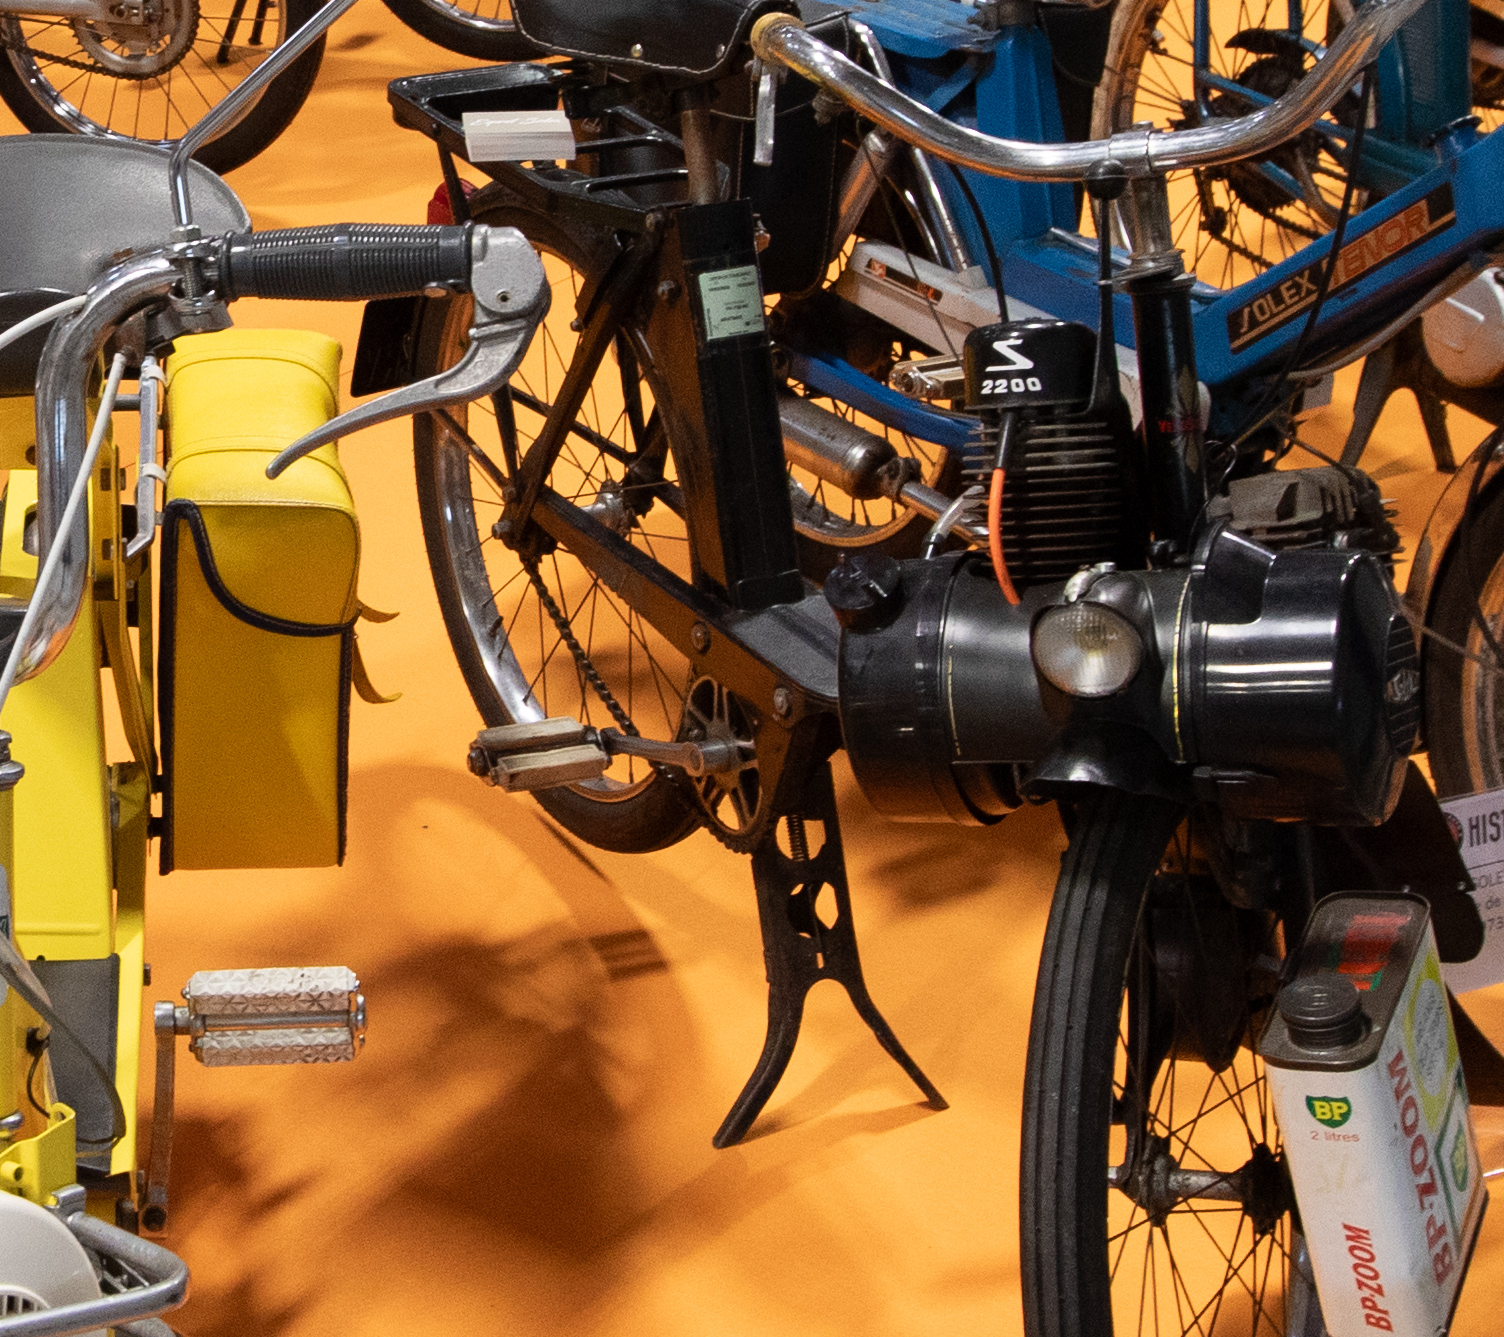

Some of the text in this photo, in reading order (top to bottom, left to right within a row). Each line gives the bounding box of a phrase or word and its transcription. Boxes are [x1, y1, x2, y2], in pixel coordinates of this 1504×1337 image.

[1239, 200, 1431, 334] SOLEX TENOR
[981, 377, 1042, 395] 2200
[1313, 1098, 1349, 1122] BP
[1310, 1129, 1360, 1144] 2 litres
